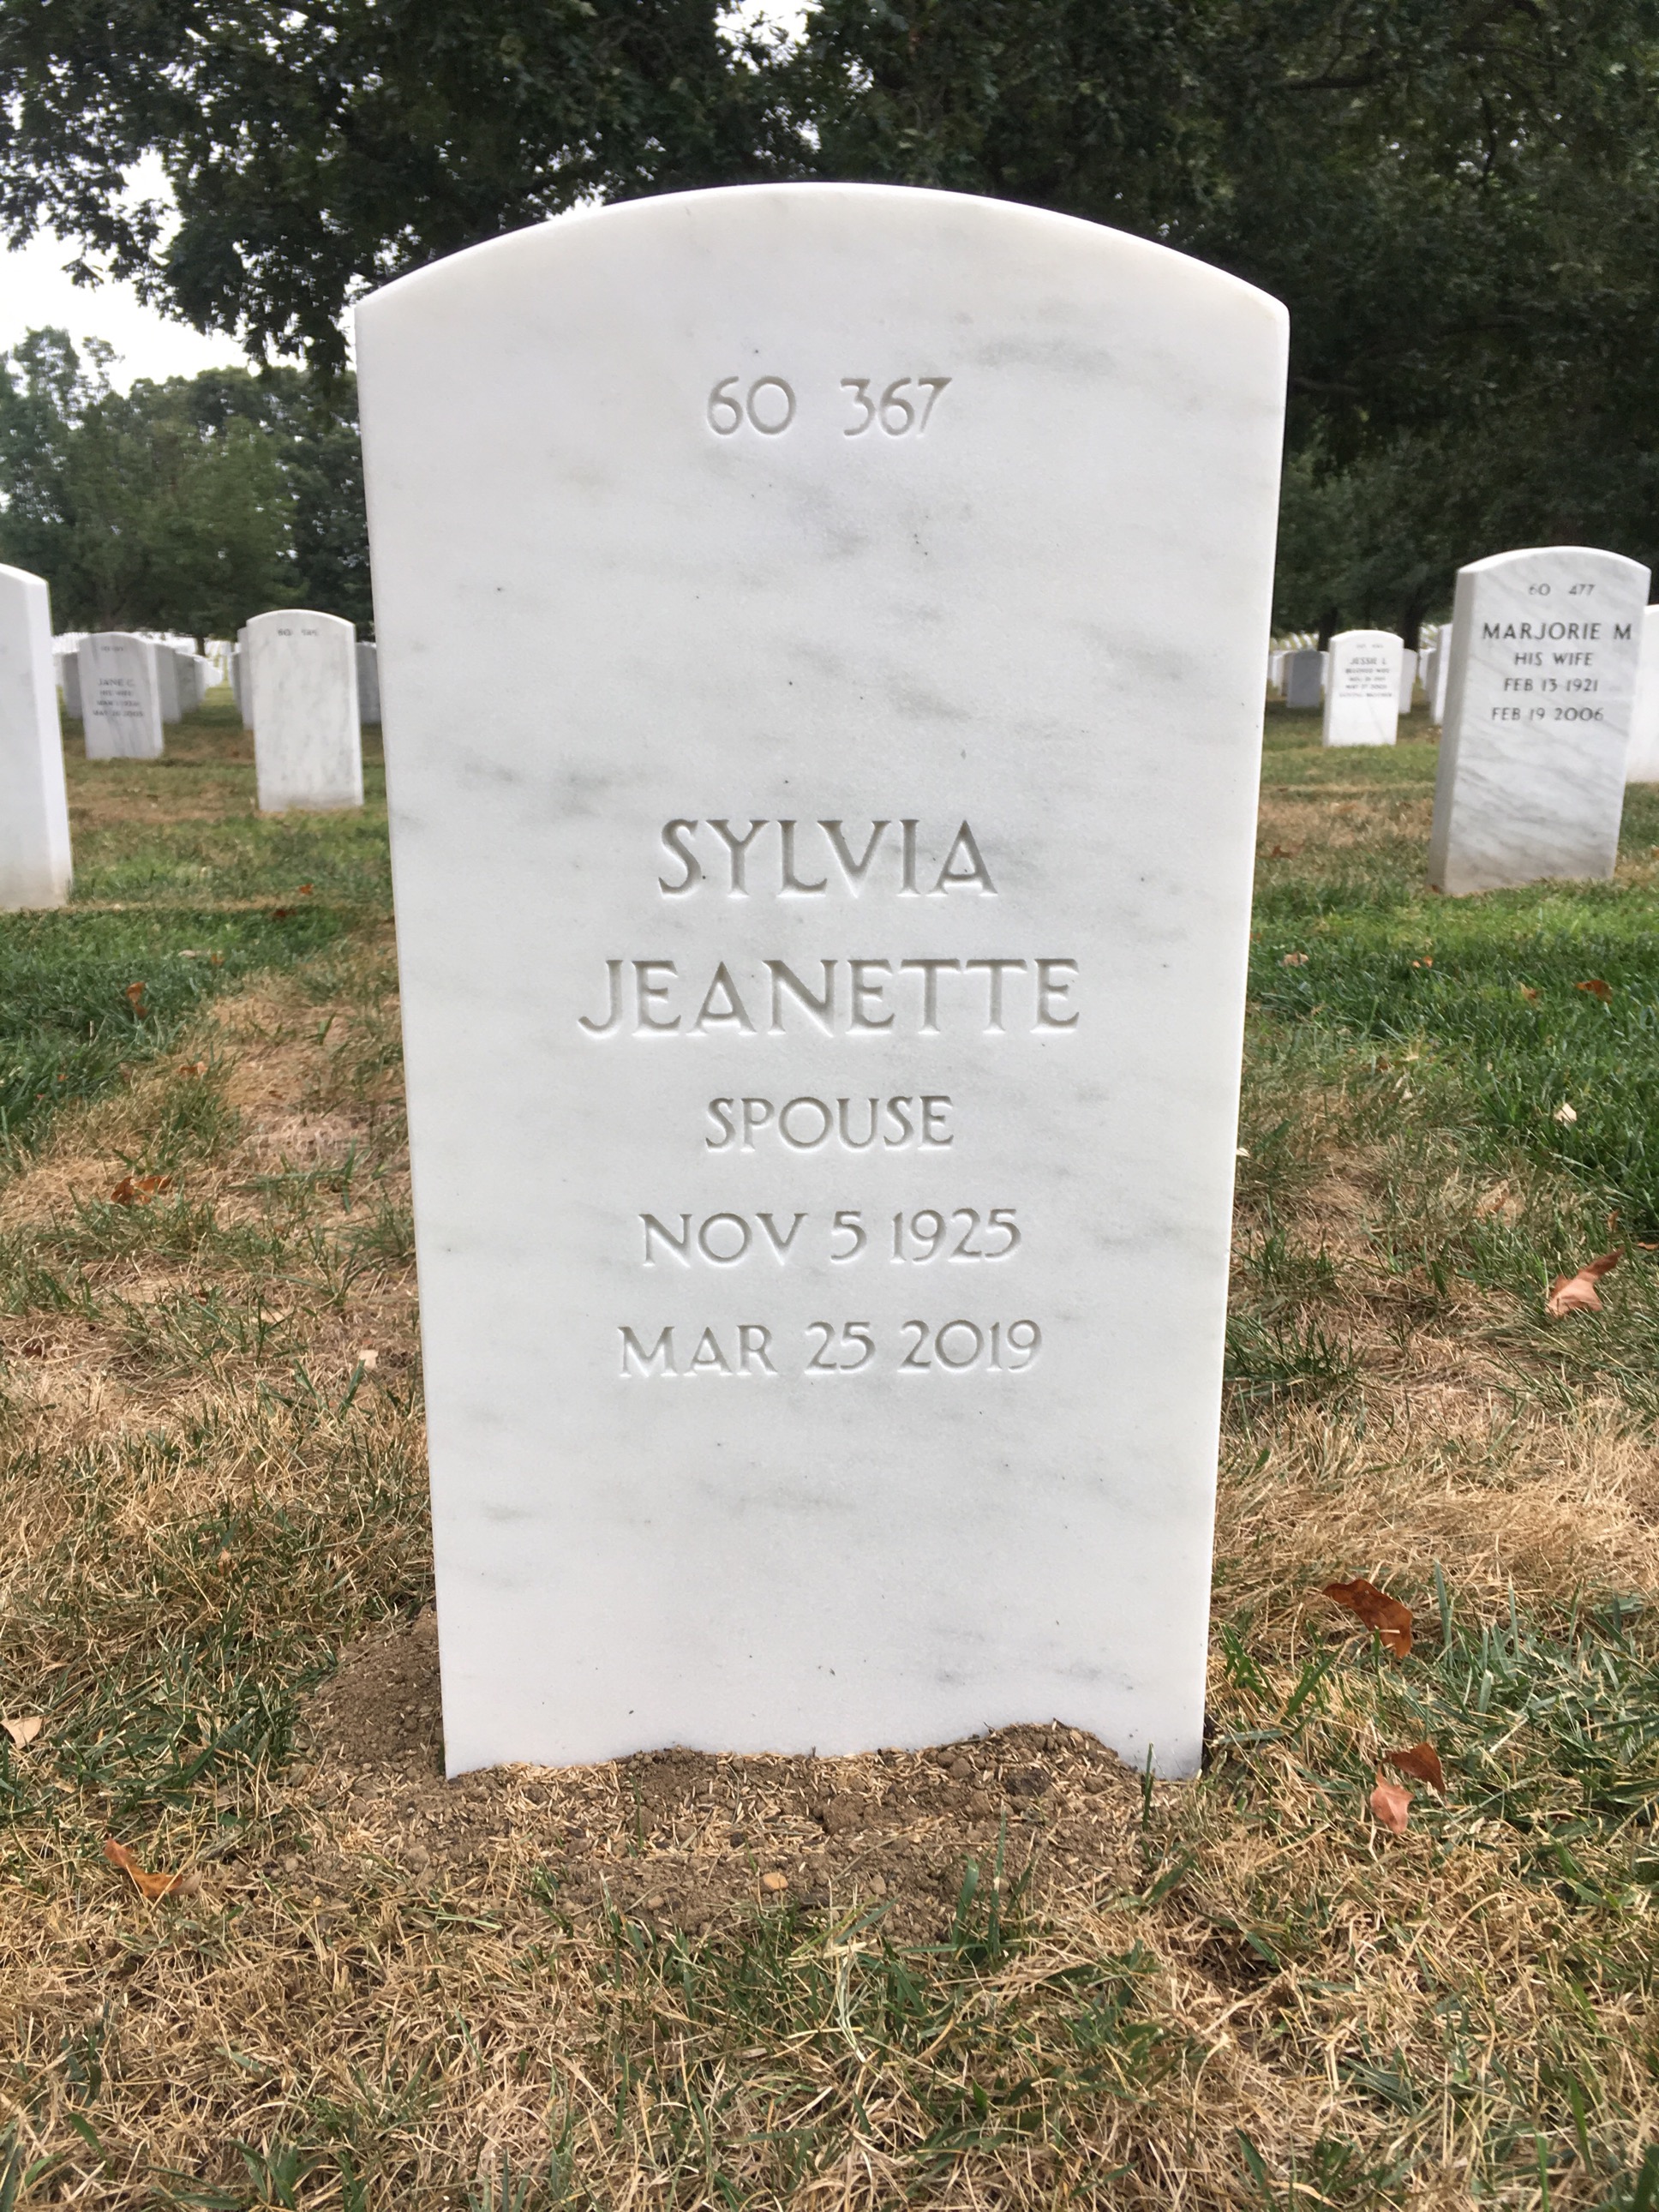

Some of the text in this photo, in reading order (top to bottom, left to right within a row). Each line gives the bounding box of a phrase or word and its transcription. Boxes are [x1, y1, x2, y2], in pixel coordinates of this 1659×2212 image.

[707, 375, 953, 438] 60 367
[1529, 583, 1596, 596] 60 477
[1482, 622, 1632, 640] MARJORIE M
[1514, 651, 1594, 666] HIS WIFE
[98, 678, 123, 686] JANE
[1503, 678, 1598, 692] FEB 13 1921
[1491, 707, 1604, 721] FEB 19 2006
[658, 818, 999, 898] SYLVIA
[578, 958, 1081, 1038] JEANETTE
[705, 1095, 955, 1153] SPOUSE
[638, 1208, 1022, 1267] NOV 5 1925
[617, 1319, 1043, 1378] MAR 25 2019
